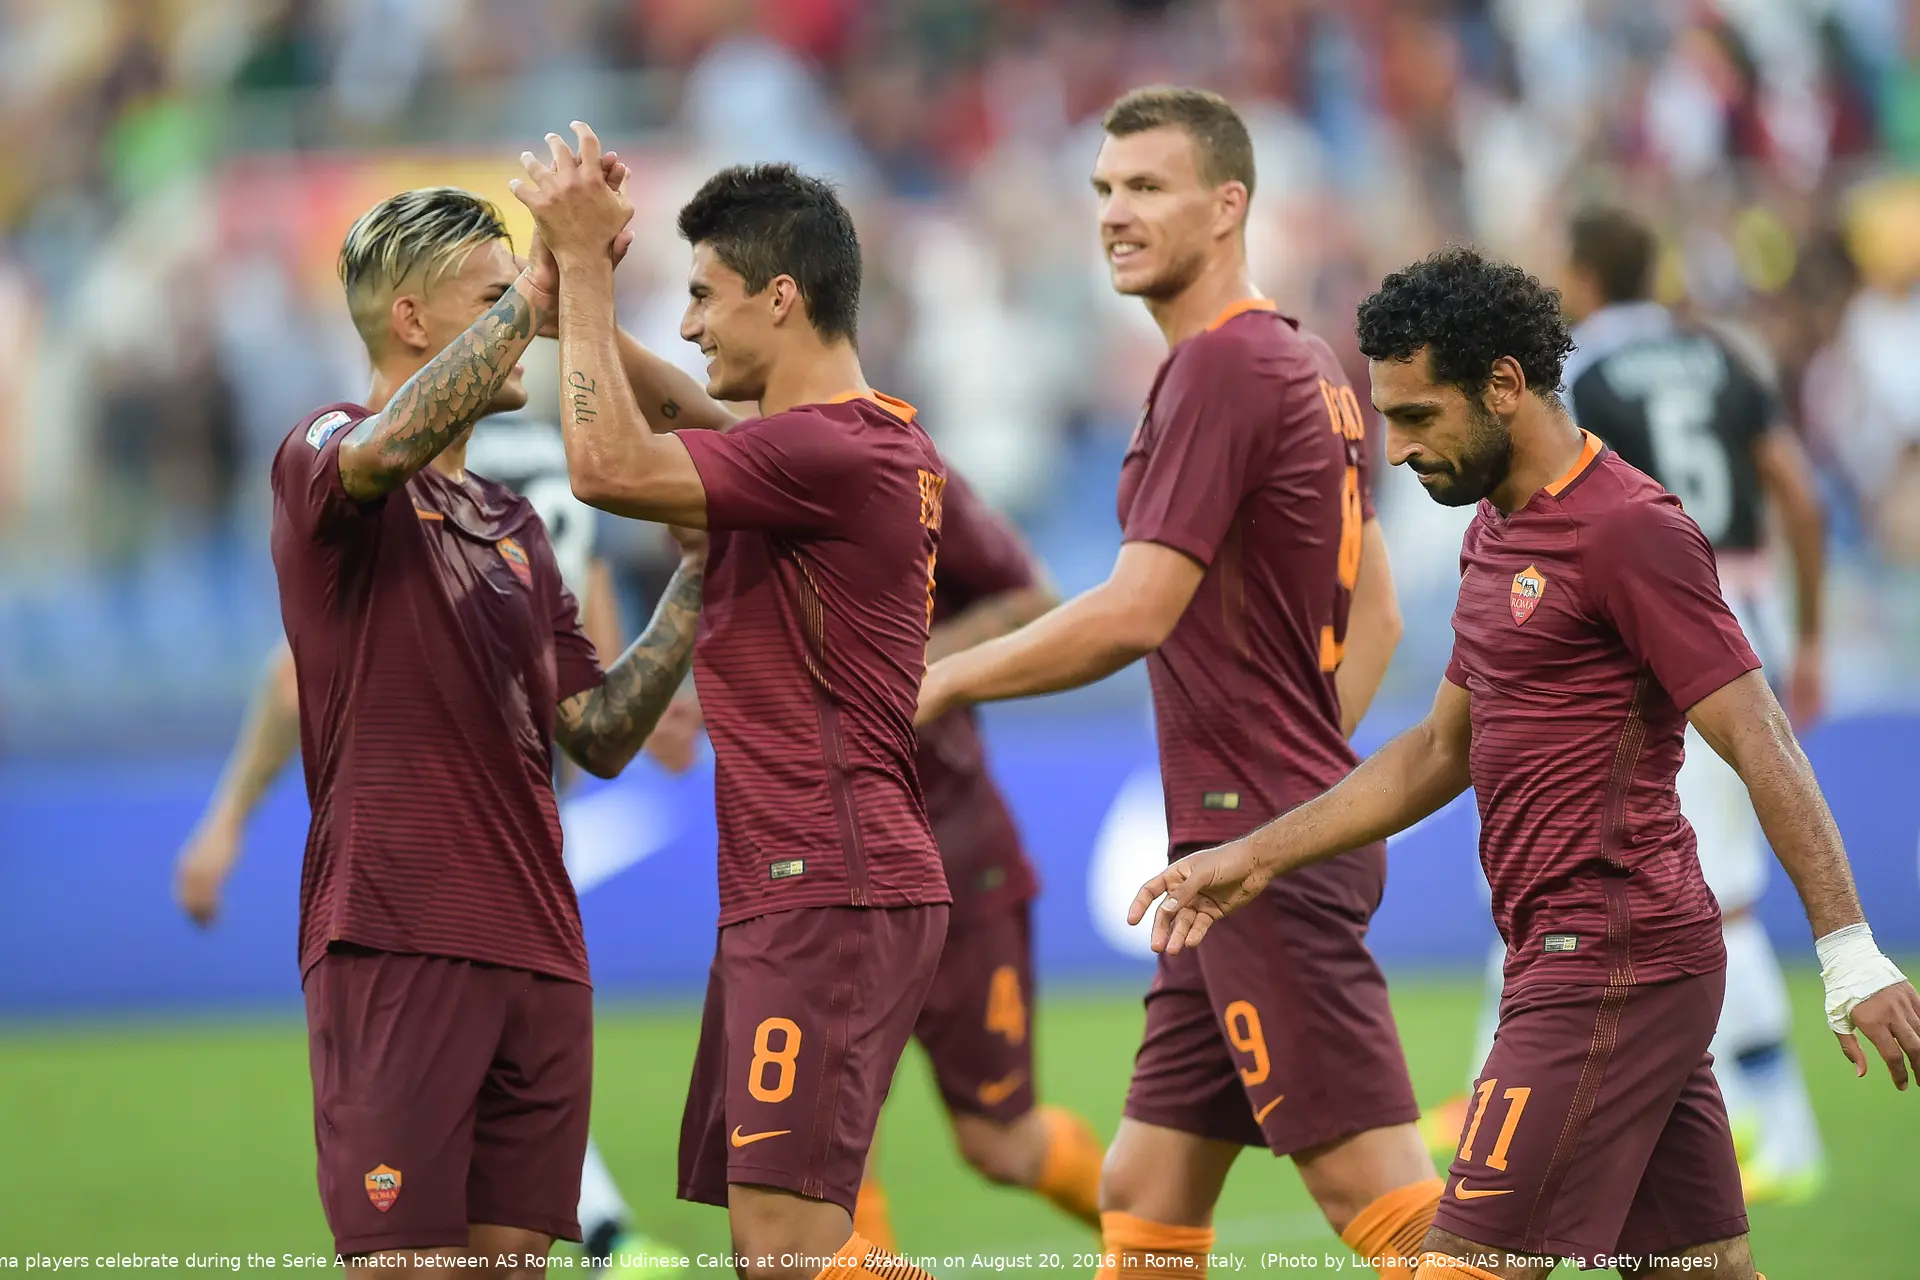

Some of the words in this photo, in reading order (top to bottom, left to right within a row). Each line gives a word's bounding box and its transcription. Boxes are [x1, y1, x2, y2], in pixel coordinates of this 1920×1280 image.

[567, 371, 597, 425] Juli
[1511, 597, 1535, 611] ROMA
[985, 966, 1026, 1045] 4
[1225, 1000, 1271, 1087] 9
[748, 1017, 802, 1103] 8
[1459, 1078, 1532, 1171] 11
